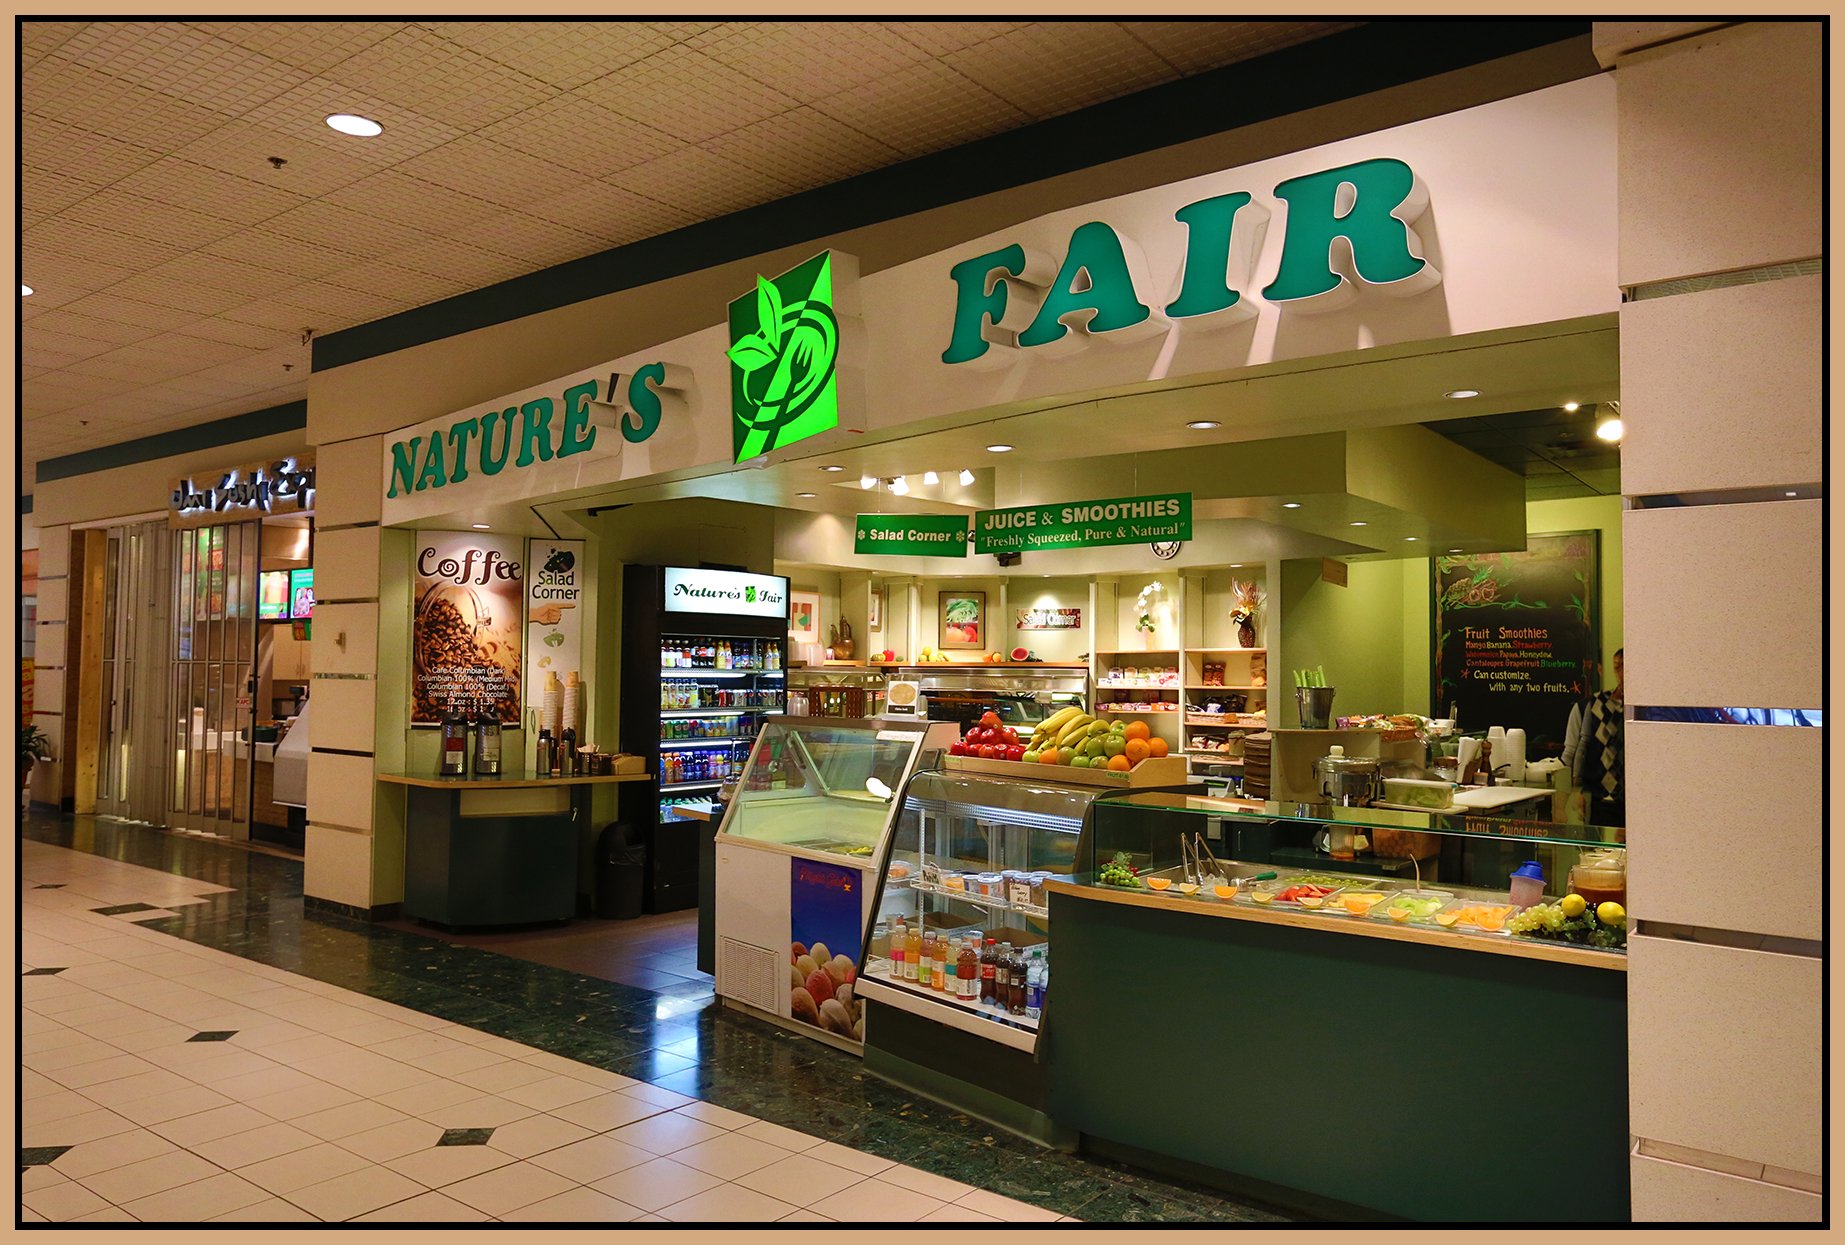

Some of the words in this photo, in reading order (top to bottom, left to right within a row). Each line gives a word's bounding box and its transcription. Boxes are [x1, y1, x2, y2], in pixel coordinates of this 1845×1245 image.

[941, 157, 1426, 364] FAIR
[386, 361, 666, 499] NATURE'S
[984, 511, 1037, 531] JUICE
[1041, 511, 1054, 526] &
[1061, 498, 1181, 524] SMOOTHIES
[869, 528, 904, 541] Salad
[907, 529, 952, 542] Corner
[1027, 529, 1082, 547] Squeezed,
[1084, 527, 1113, 541] Pure
[1115, 526, 1127, 539] &
[417, 546, 522, 586] Coffee
[538, 570, 575, 586] Salad
[532, 584, 580, 600] Corner
[673, 582, 741, 600] Nature's
[758, 589, 783, 604] Fair
[1464, 626, 1490, 640] Fruit
[1498, 625, 1549, 640] Smoothies
[449, 666, 486, 675] Columbian
[1473, 670, 1489, 680] Can
[417, 674, 452, 684] Columbian
[454, 675, 475, 683] 100%
[426, 683, 463, 691] Columbian
[465, 683, 485, 691] 100%
[1509, 684, 1524, 694] any
[1525, 682, 1541, 693] two
[428, 691, 448, 699] Swiss
[449, 691, 476, 699] Almond
[477, 691, 509, 699] Chocolate
